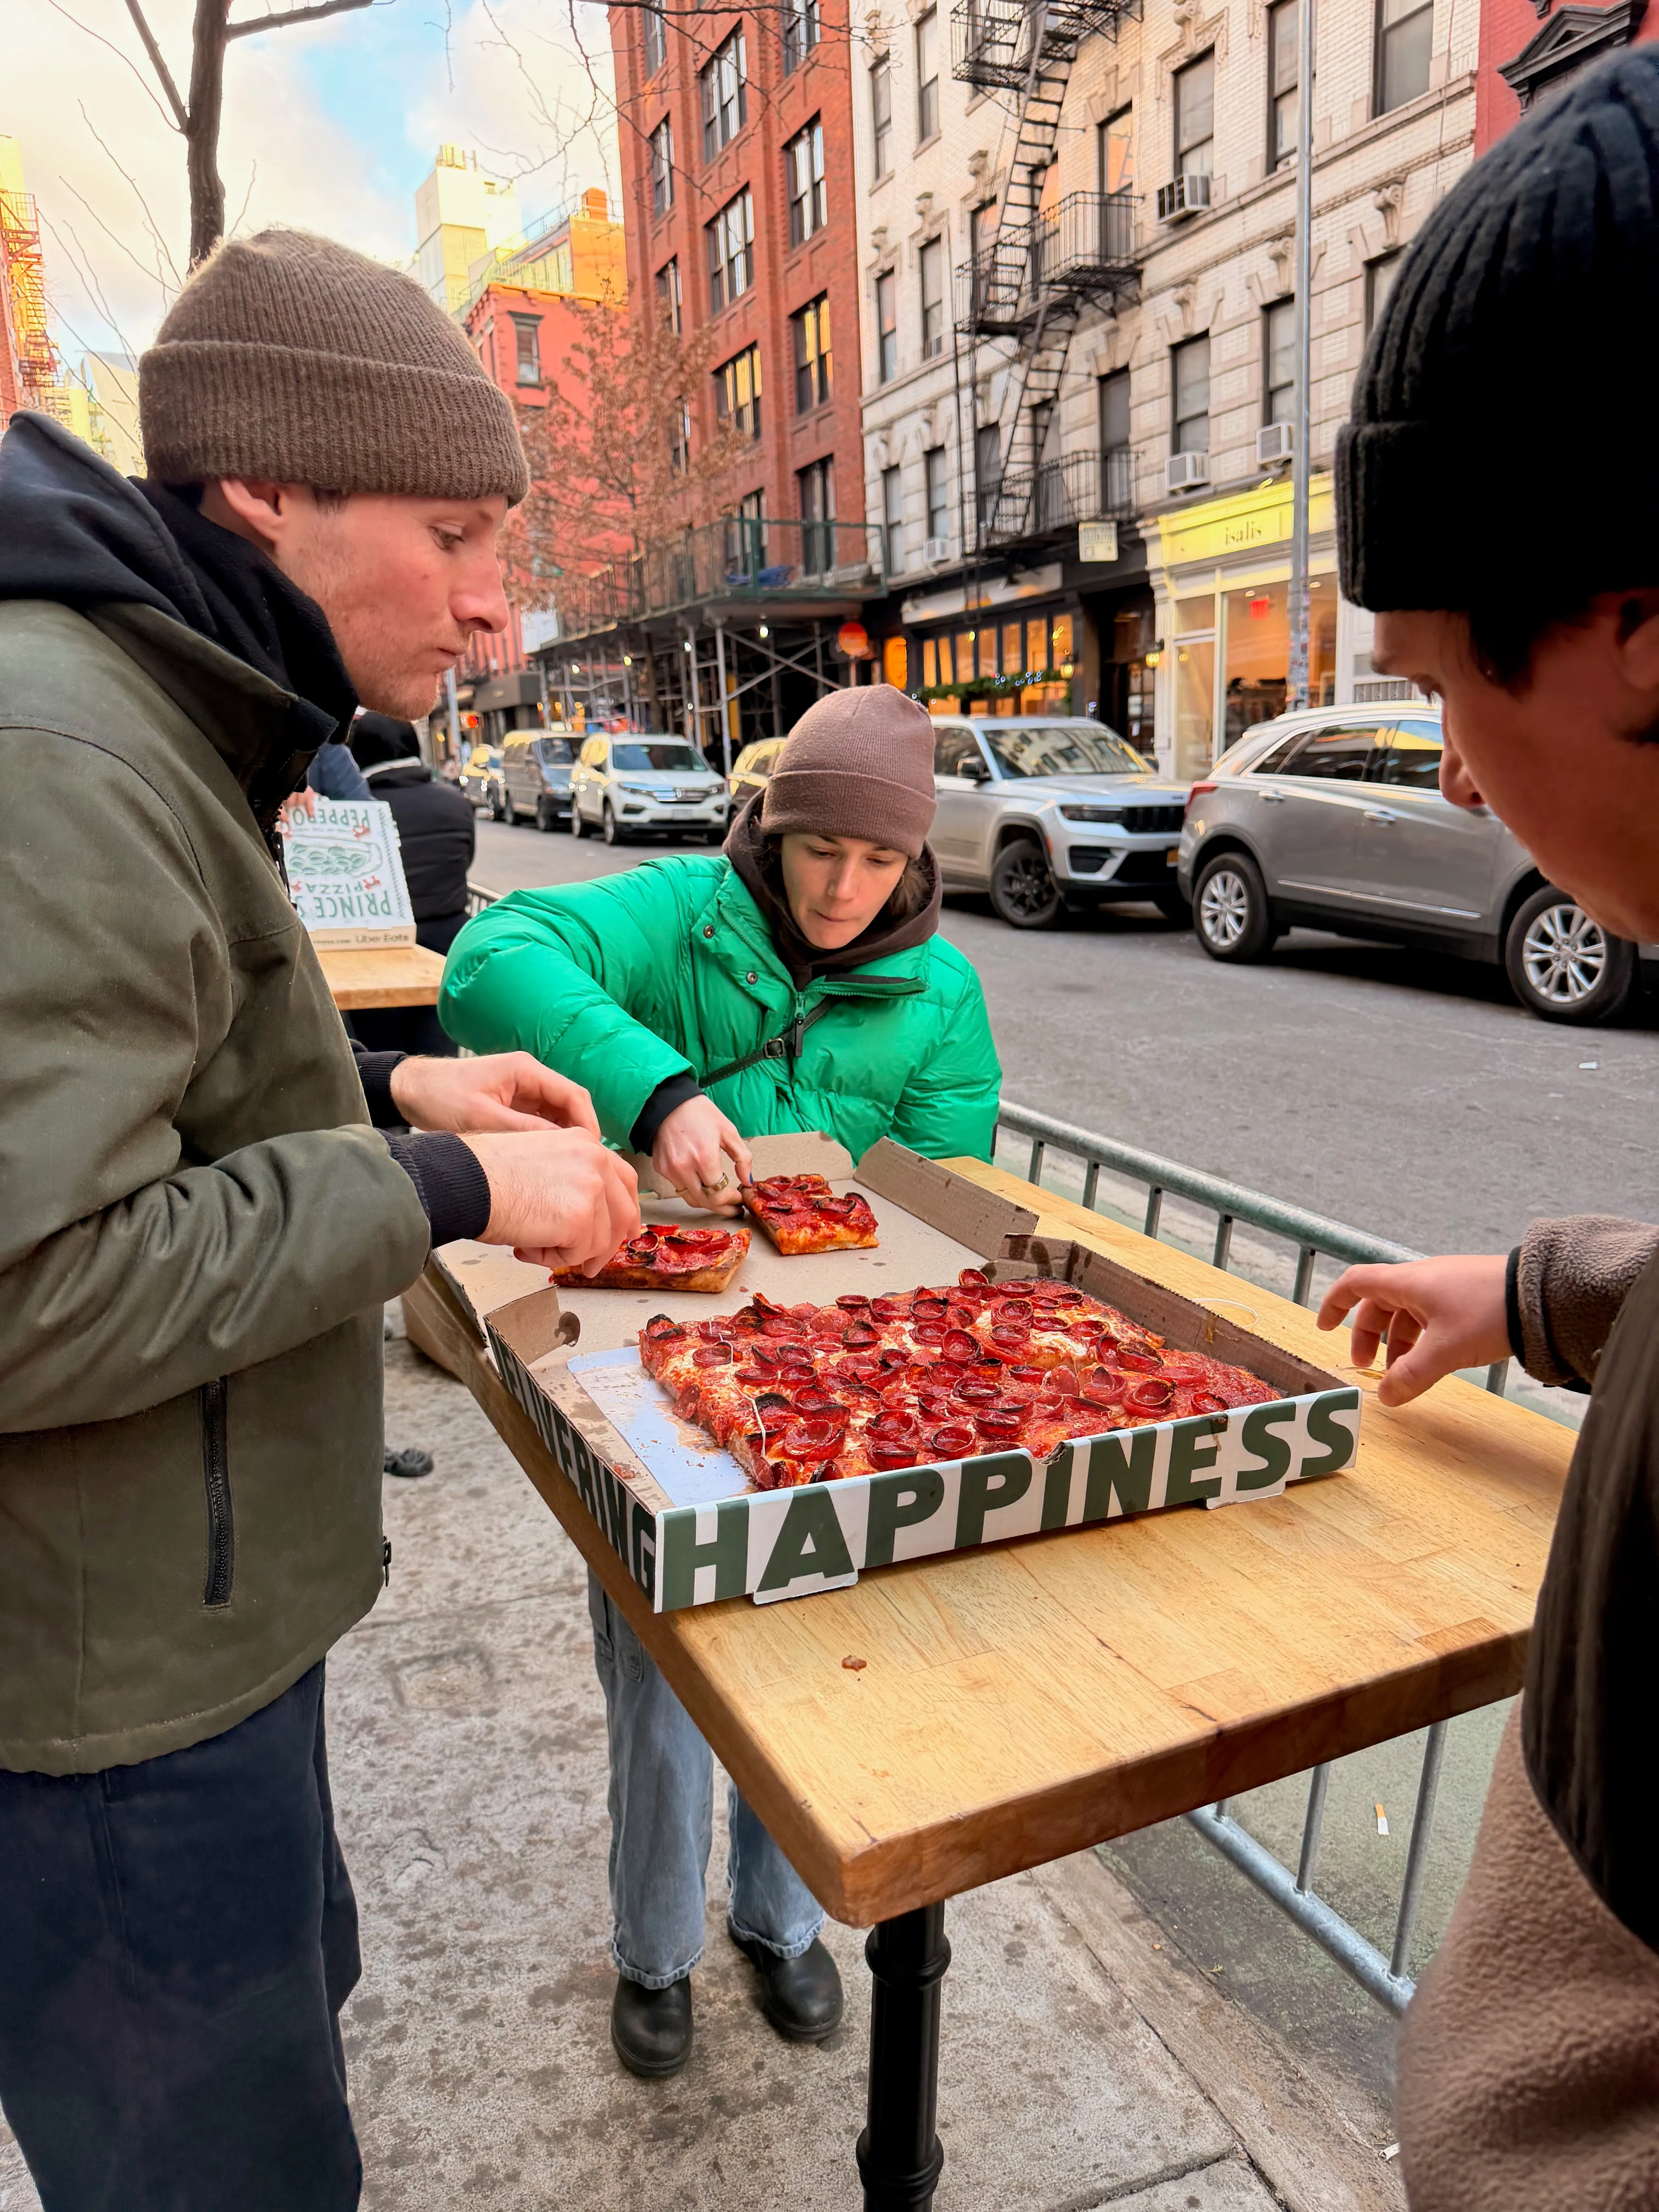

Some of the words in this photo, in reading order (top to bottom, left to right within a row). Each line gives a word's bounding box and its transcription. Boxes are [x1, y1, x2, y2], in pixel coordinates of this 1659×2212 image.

[305, 881, 362, 895] PIZZA
[314, 891, 392, 919] PRINCE
[356, 934, 381, 943] Uber
[384, 933, 409, 942] Eats
[662, 1388, 1359, 1612] HAPPINESS
